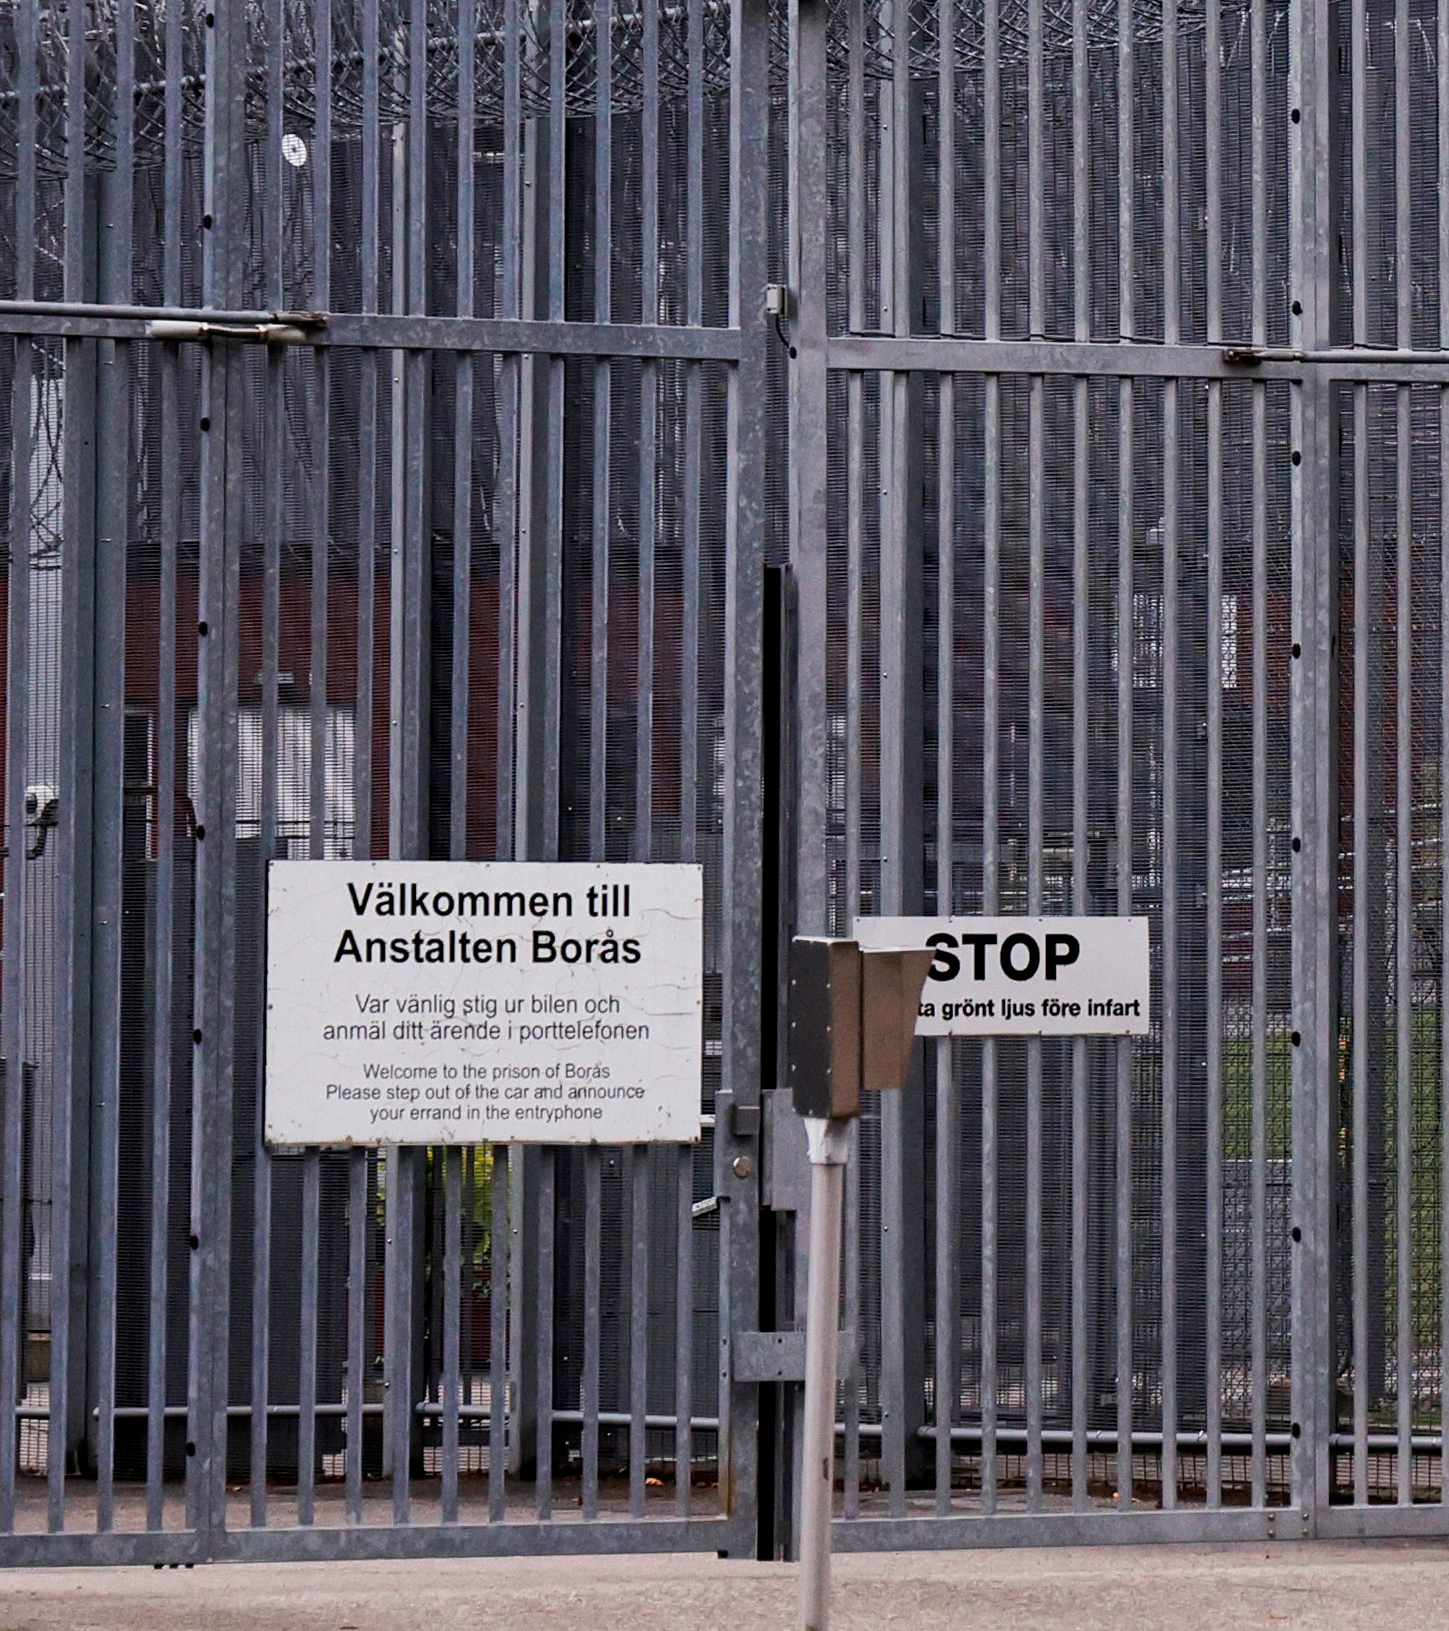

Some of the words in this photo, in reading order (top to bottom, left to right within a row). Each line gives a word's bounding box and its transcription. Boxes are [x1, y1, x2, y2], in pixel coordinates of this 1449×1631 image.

[347, 882, 573, 917] Välkommen
[586, 884, 631, 917] till
[333, 929, 517, 964] Anstalten
[532, 928, 642, 964] Borås
[925, 932, 1080, 982] STOP
[355, 994, 390, 1014] Var
[396, 994, 456, 1019] vänlig
[462, 995, 497, 1019] stig
[504, 998, 525, 1014] ur
[531, 994, 578, 1014] bilen
[584, 994, 620, 1014] och
[941, 998, 994, 1021] grönt
[1001, 998, 1036, 1021] ljus
[1040, 998, 1082, 1018] före
[1087, 998, 1141, 1018] infart
[323, 1020, 387, 1041] anmäl
[392, 1020, 425, 1041] ditt
[430, 1020, 501, 1041] ärende
[508, 1020, 513, 1041] i
[519, 1019, 650, 1044] porttelefonen
[363, 1064, 438, 1079] Welcome
[443, 1064, 458, 1079] to
[463, 1064, 487, 1079] the
[492, 1064, 541, 1082] prison
[545, 1063, 561, 1079] of
[326, 1084, 381, 1100] Please
[386, 1085, 420, 1104] step
[425, 1085, 450, 1100] out
[455, 1084, 471, 1100] of
[475, 1084, 499, 1100] the
[504, 1087, 530, 1100] car
[534, 1084, 563, 1100] and
[568, 1086, 645, 1100] announce
[370, 1107, 405, 1123] your
[410, 1105, 462, 1120] errand
[466, 1105, 481, 1120] in
[485, 1105, 510, 1120] the
[515, 1105, 603, 1124] entryphone
